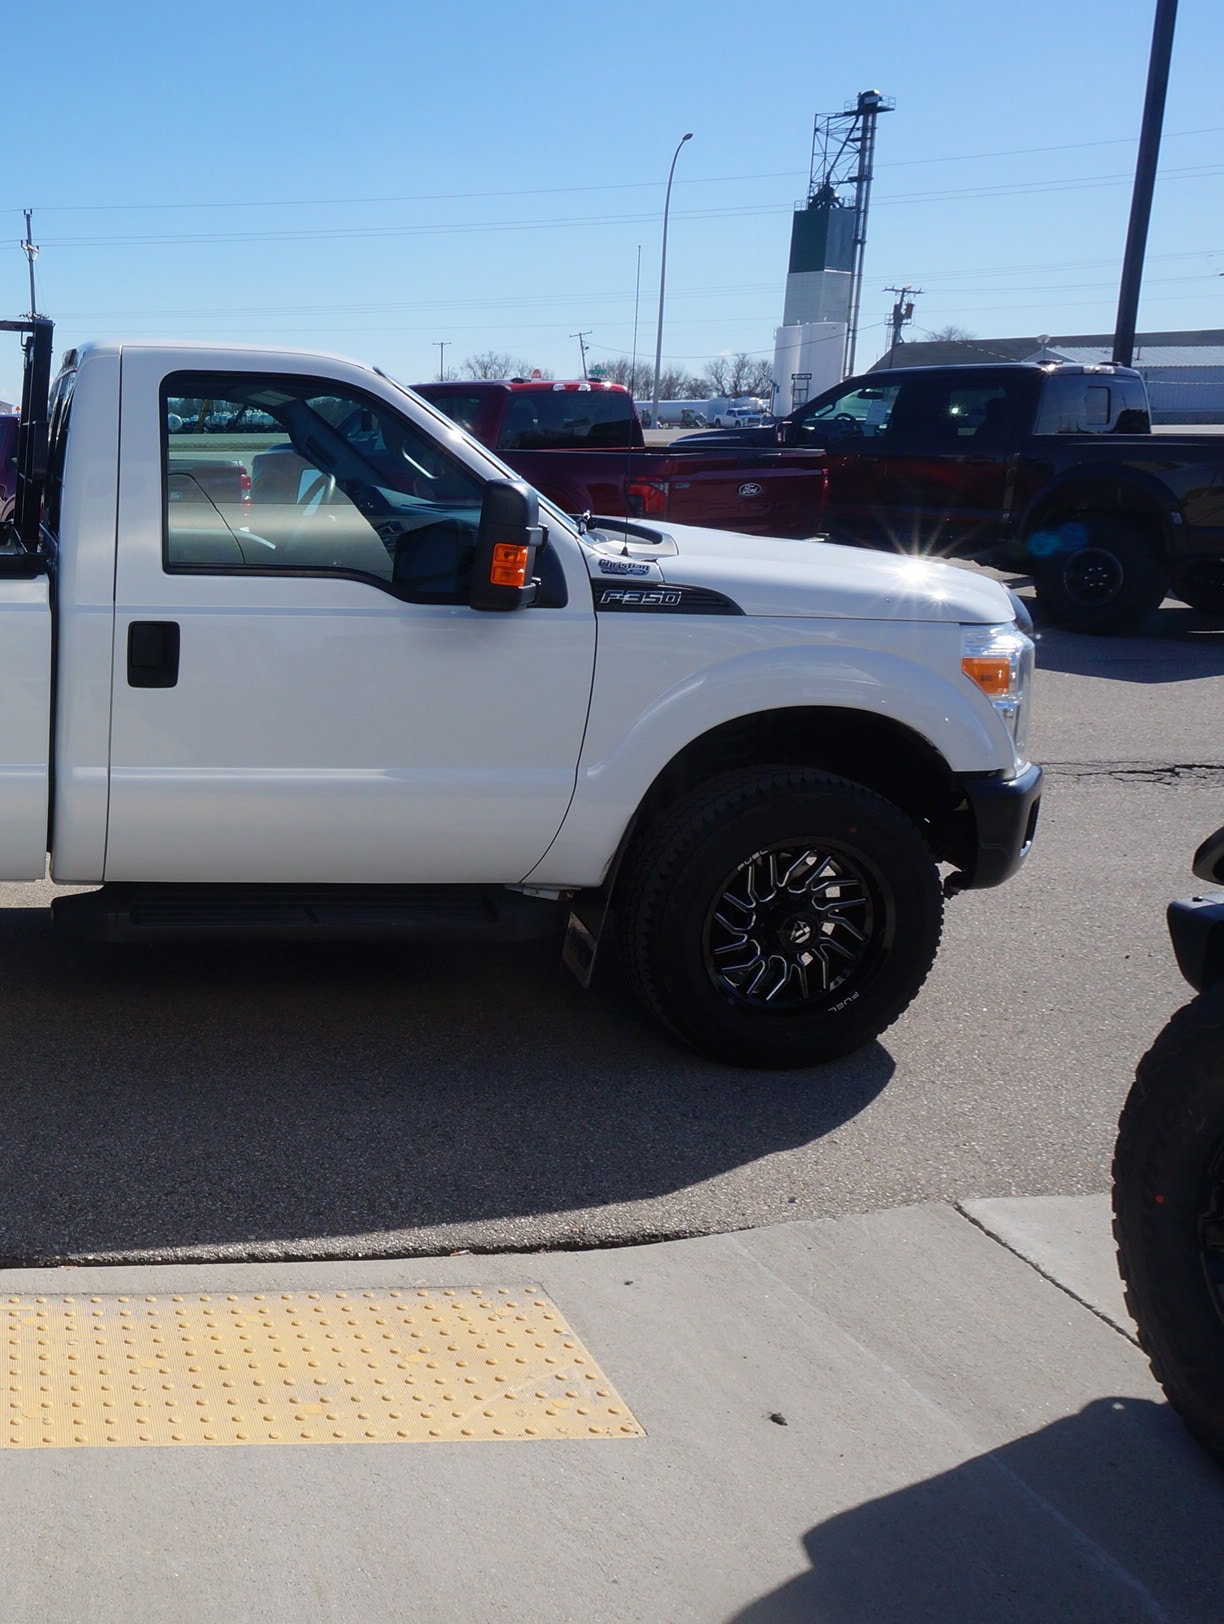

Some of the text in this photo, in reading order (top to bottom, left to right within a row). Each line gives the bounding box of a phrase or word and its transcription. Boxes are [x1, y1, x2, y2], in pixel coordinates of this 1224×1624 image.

[598, 558, 651, 571] Christian
[737, 850, 769, 871] FUEL
[828, 991, 860, 1012] FUEL
